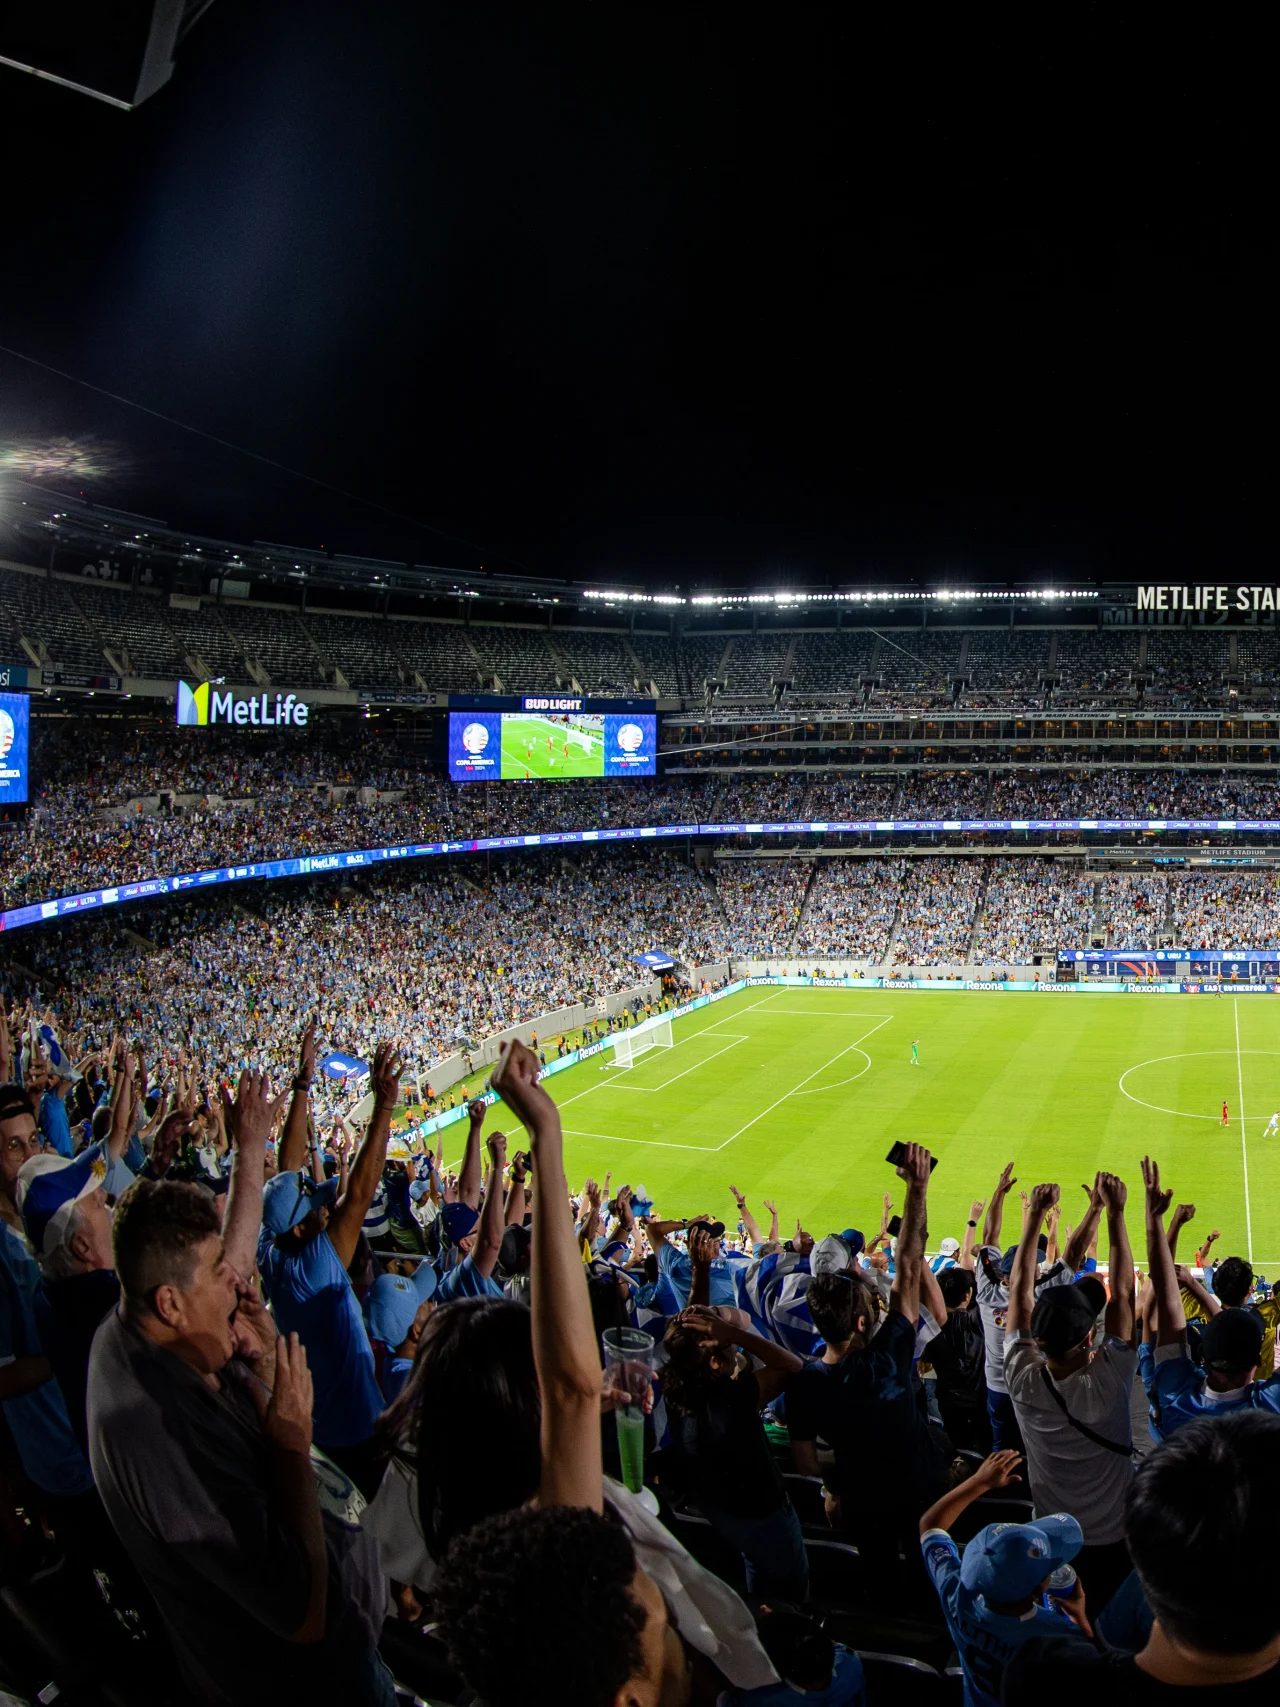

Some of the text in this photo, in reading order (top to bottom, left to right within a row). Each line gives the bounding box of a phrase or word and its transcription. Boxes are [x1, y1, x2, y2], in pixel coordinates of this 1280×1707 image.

[1137, 586, 1228, 610] METLIFE
[210, 691, 309, 726] MetLife
[525, 698, 581, 710] BUD LIGHT
[311, 856, 338, 869] MetLife
[140, 884, 156, 893] ULTRA
[80, 896, 96, 905] ULTRA
[1185, 952, 1190, 960] 3
[747, 977, 778, 986] Rexona
[813, 978, 846, 987] Rexona
[883, 979, 918, 990] Rexona
[967, 980, 1003, 991] Rexona
[1038, 981, 1076, 992] Rexona
[1128, 984, 1166, 992] Rexona
[710, 989, 728, 1001] Rexona
[674, 1004, 693, 1018] Rexona
[579, 1041, 604, 1060] Rexona
